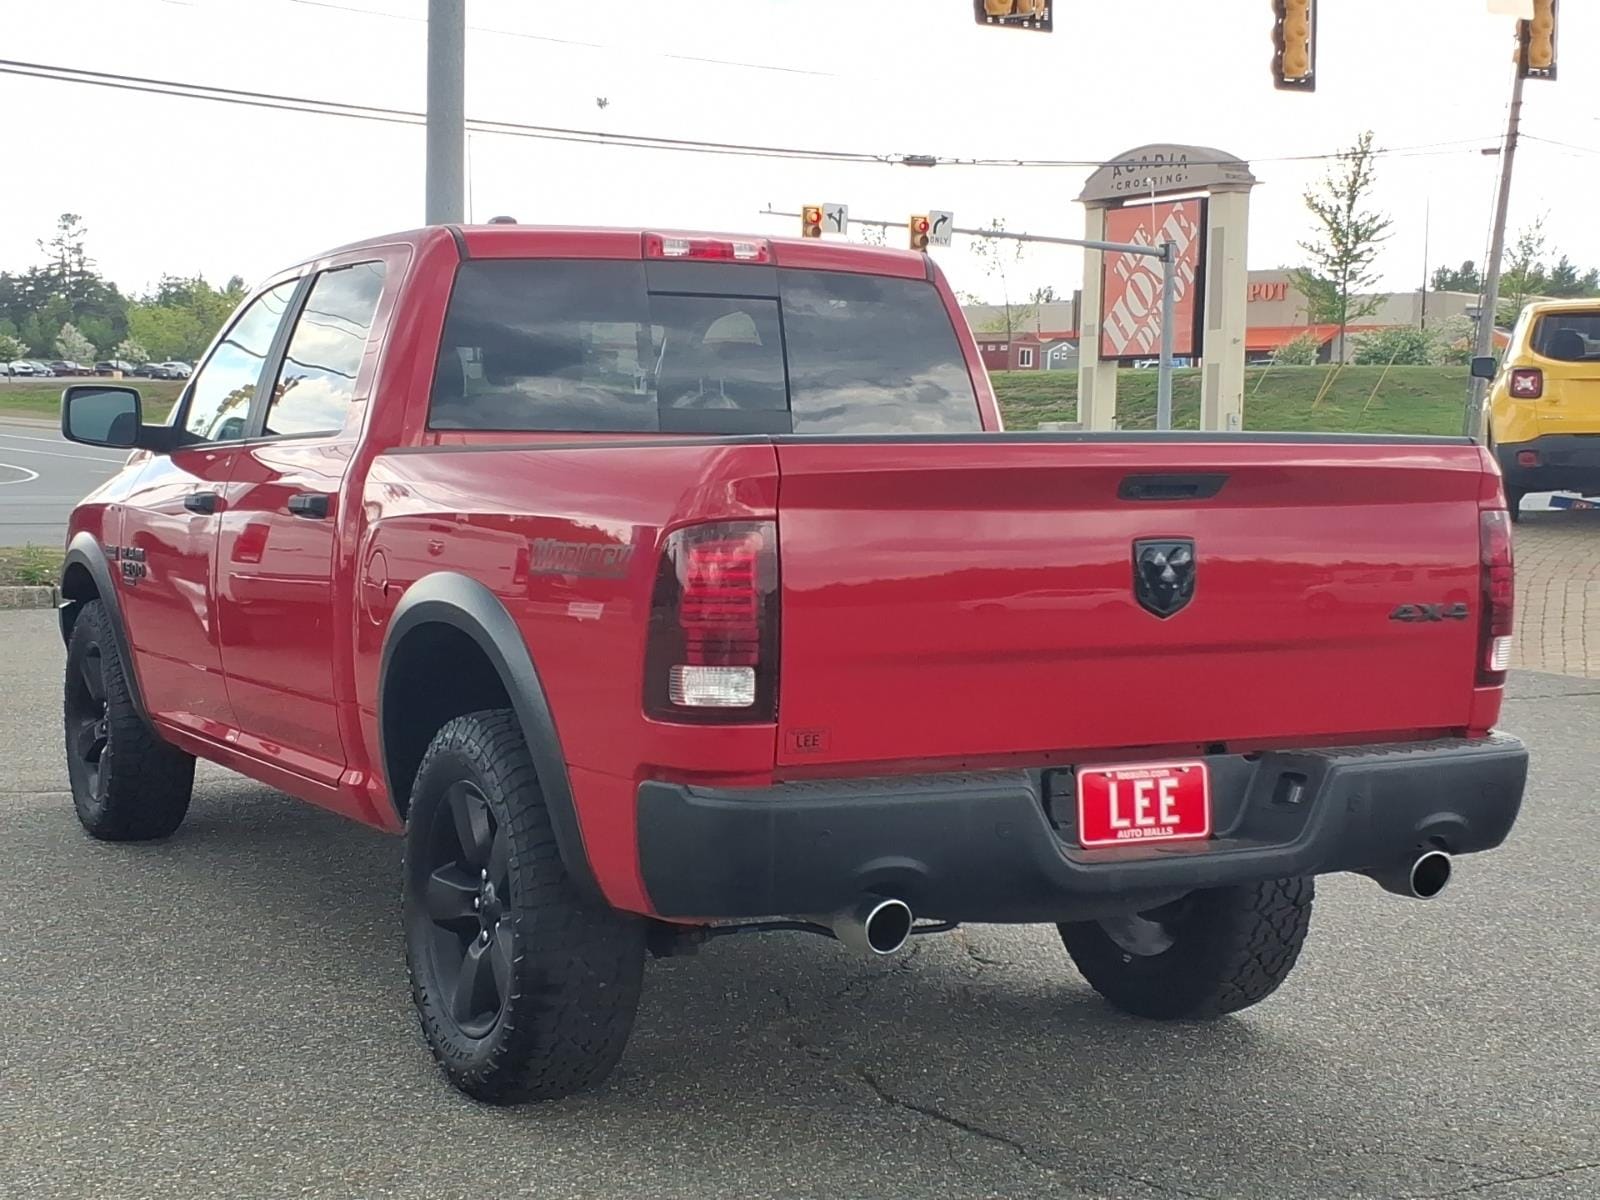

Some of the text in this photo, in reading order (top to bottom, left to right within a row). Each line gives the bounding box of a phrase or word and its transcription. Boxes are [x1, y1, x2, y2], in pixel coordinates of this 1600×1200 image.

[1112, 152, 1192, 179] ACADIA
[1117, 173, 1182, 191] CROSSING
[930, 235, 949, 246] ONLY
[1247, 282, 1289, 302] POT
[796, 734, 820, 748] LEE
[1108, 777, 1181, 830] LEE
[1117, 826, 1174, 839] AUTO MALLS
